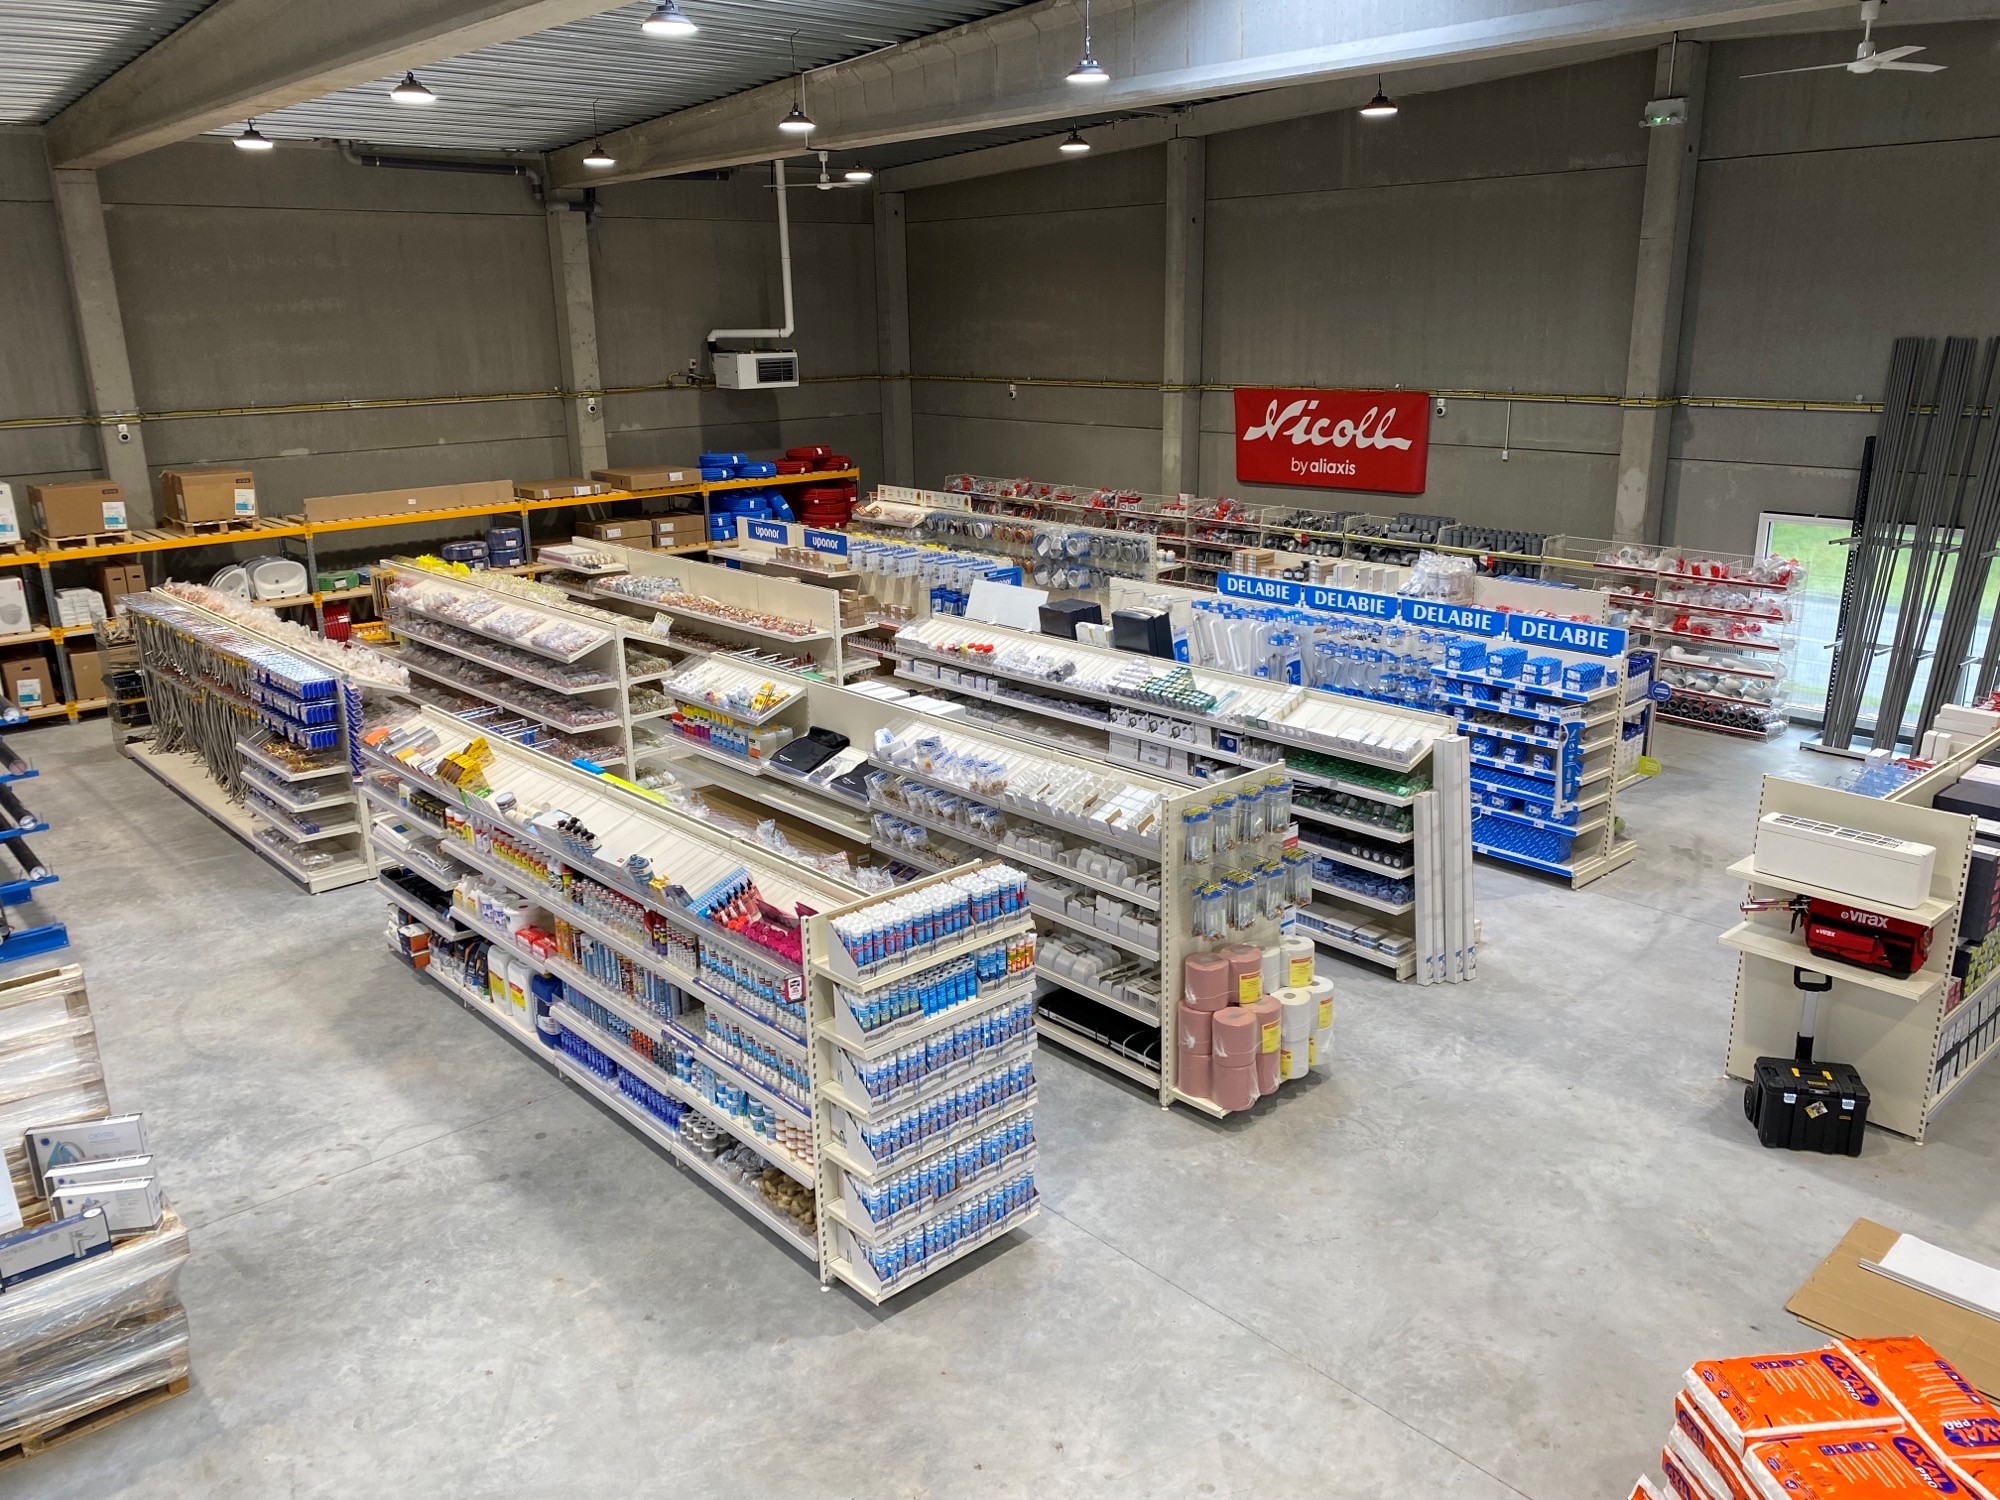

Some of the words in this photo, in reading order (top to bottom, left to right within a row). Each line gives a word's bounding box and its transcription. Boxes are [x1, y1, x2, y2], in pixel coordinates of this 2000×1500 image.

[1243, 399, 1412, 450] Nicoll
[1291, 457, 1308, 475] by
[1310, 460, 1356, 475] aliaxis
[755, 526, 779, 539] uponor
[812, 536, 839, 549] uponor
[1227, 578, 1290, 600] DELABIE
[1315, 590, 1385, 615] DELABIE
[1413, 604, 1492, 631] DELABIE
[1521, 620, 1609, 649] DELABIE
[1849, 910, 1889, 928] virax
[1819, 929, 1836, 937] virax
[1830, 1359, 1872, 1401] AXAL
[1840, 1379, 1861, 1401] PRO
[1945, 1418, 1971, 1431] PRO
[1902, 1442, 1948, 1489] AXAL
[1915, 1467, 1938, 1489] PRO
